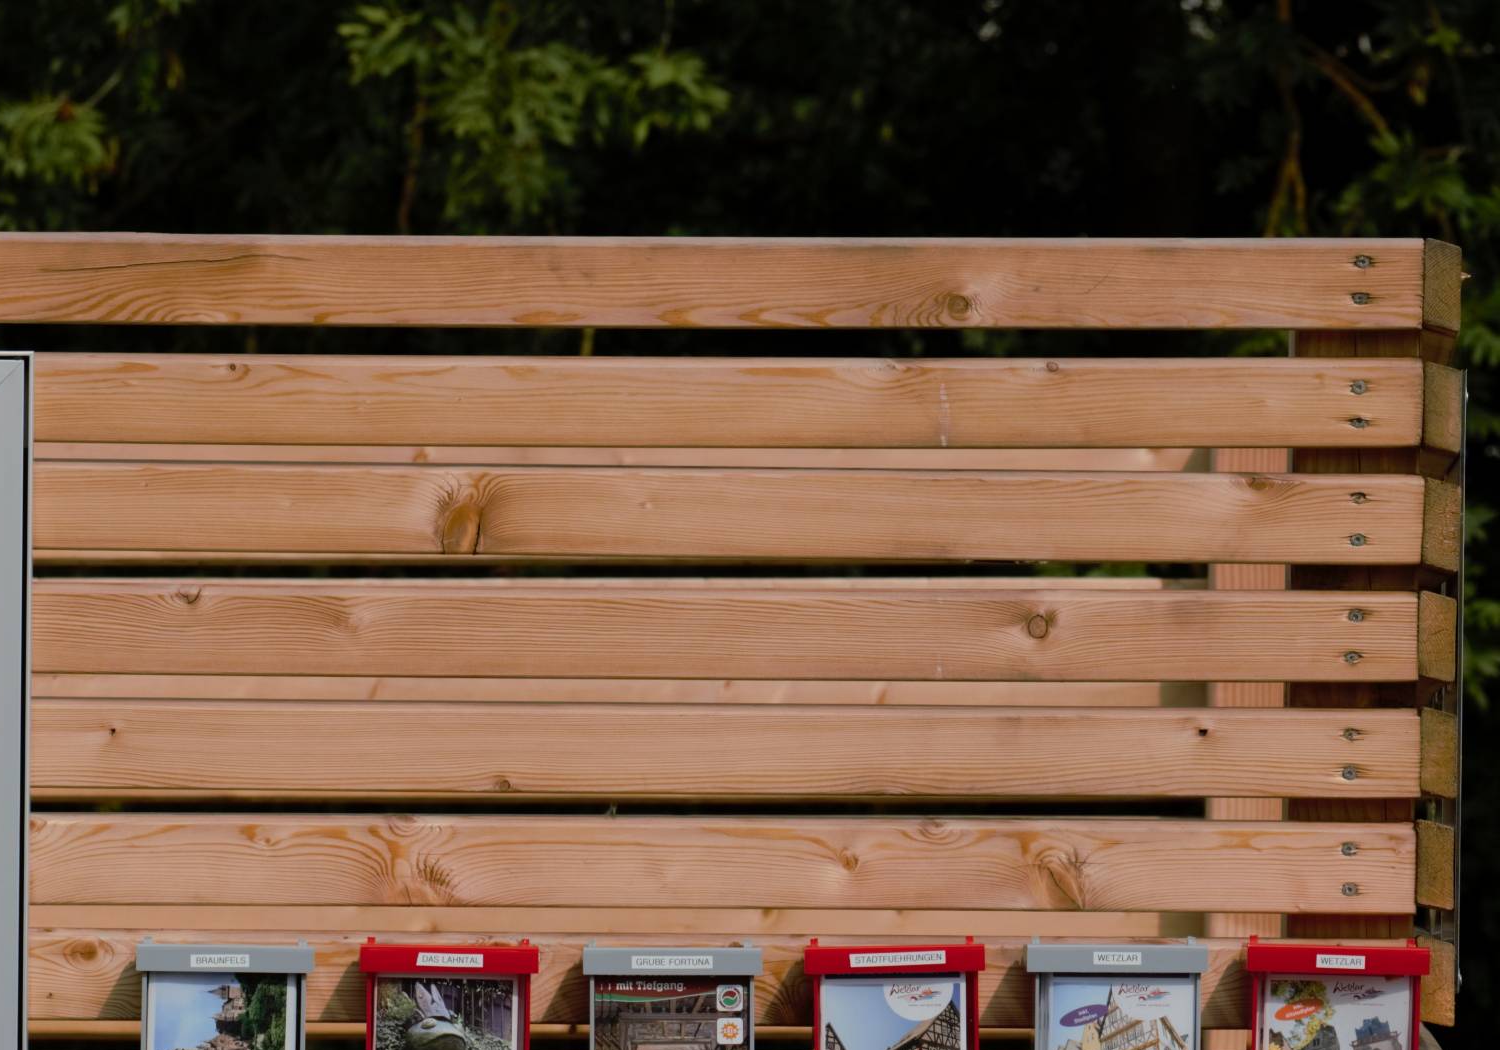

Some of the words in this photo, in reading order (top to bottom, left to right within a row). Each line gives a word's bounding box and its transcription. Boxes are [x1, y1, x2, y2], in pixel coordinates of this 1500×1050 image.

[196, 956, 246, 965] BRAUNFELS
[421, 954, 440, 963] DAS
[442, 955, 479, 964] LAHNTAL
[635, 957, 667, 966] GRUBE
[668, 957, 710, 966] FORTUNA
[854, 953, 942, 964] STADTFUEHRUNGEN
[1097, 954, 1138, 962] WETZLAR
[1320, 957, 1363, 965] WETZLAR
[616, 981, 634, 991] mit
[635, 981, 687, 992] Tiefgang.
